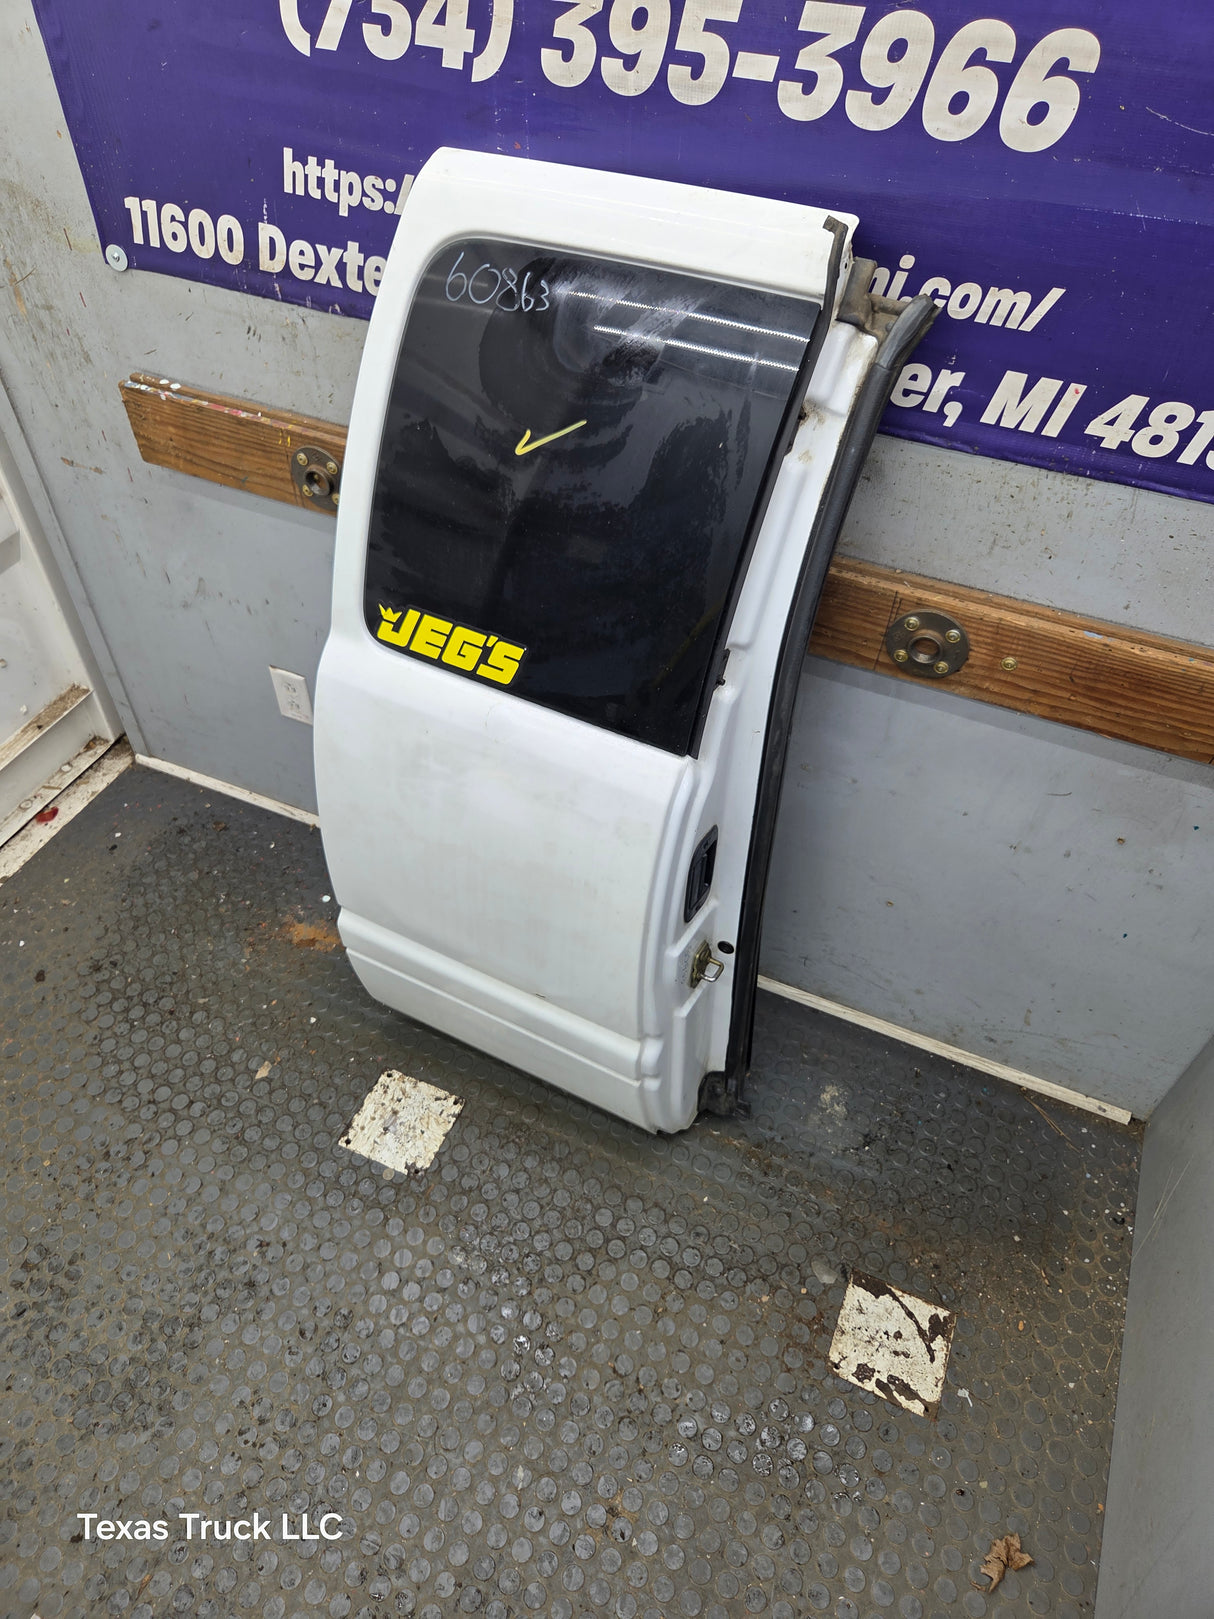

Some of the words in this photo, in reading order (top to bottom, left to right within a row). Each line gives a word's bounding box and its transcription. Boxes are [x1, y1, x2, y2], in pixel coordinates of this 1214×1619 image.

[541, 0, 1101, 153] 395-3966
[123, 196, 244, 266] 11600
[890, 363, 966, 427] er,
[979, 370, 1088, 438] MI
[1083, 394, 1214, 471] 481
[445, 251, 550, 312] 60863
[377, 605, 527, 685] JEG'S
